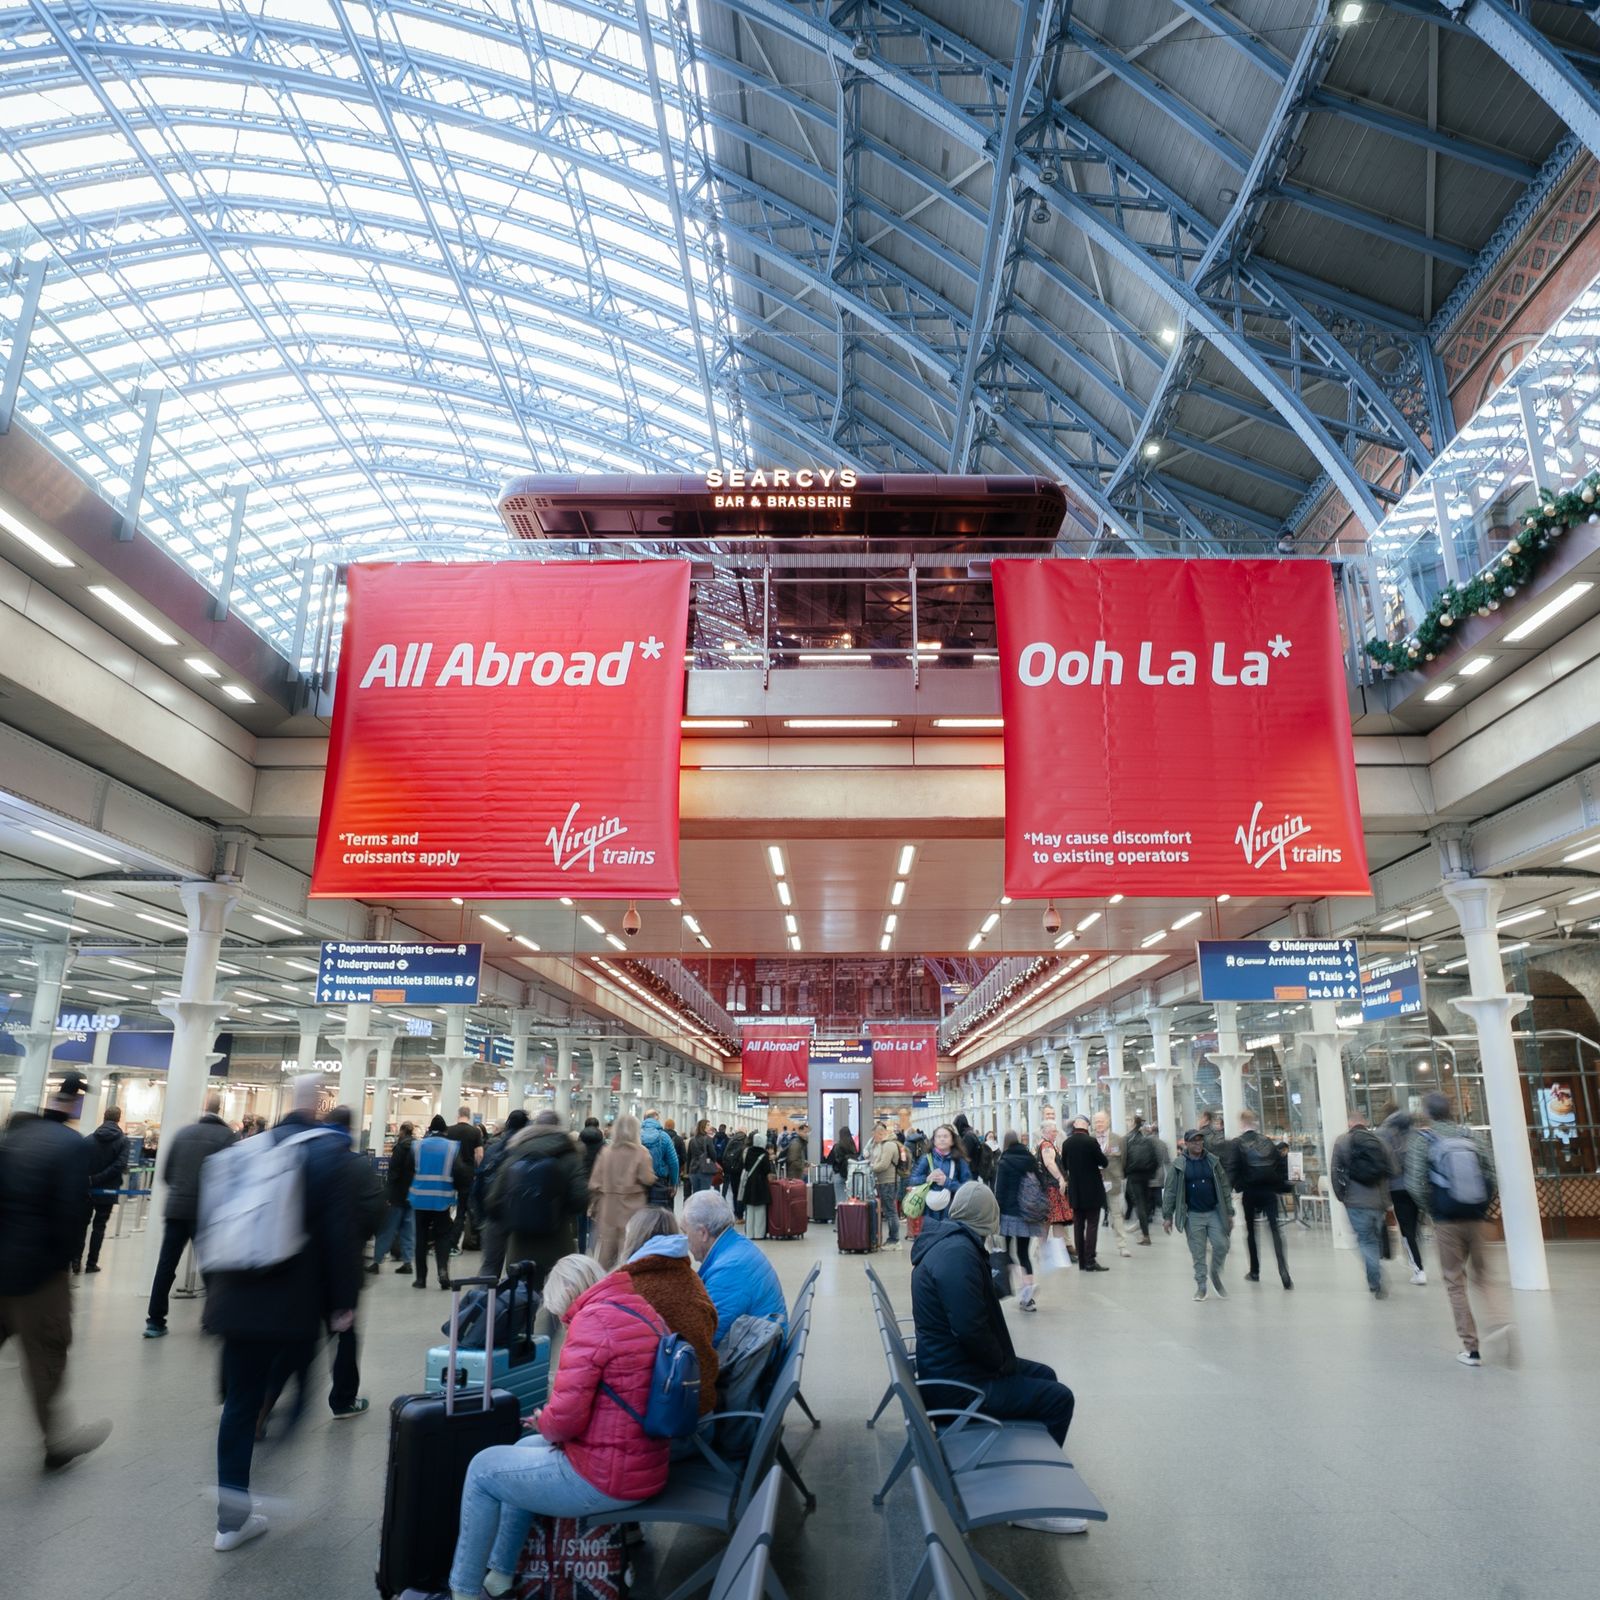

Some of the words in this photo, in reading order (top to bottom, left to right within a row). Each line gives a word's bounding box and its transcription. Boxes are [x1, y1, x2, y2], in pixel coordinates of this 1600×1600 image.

[706, 469, 857, 488] SEARCYS
[715, 495, 745, 508] BAR
[750, 495, 762, 508] &
[767, 495, 852, 508] BRASSERIE
[359, 642, 433, 689] All
[1018, 640, 1124, 687] Ooh
[1137, 641, 1197, 686] La
[391, 832, 419, 846] and
[545, 802, 628, 873] Virgin
[1065, 834, 1109, 846] cause
[1112, 830, 1192, 845] discomfort
[1235, 800, 1312, 871] Virgin
[342, 849, 416, 865] croissants
[419, 849, 460, 867] apply
[602, 846, 656, 865] trains
[1033, 850, 1049, 863] to
[1053, 849, 1115, 866] existing
[1117, 850, 1190, 865] operators
[1292, 845, 1342, 864] trains
[338, 943, 388, 956] Departures
[389, 943, 424, 956] Départs
[1282, 940, 1340, 953] Underground
[336, 958, 396, 971] Underground
[1268, 955, 1306, 966] Arrivées
[1306, 955, 1342, 966] Arrivals
[335, 974, 392, 986] International
[393, 974, 423, 986] tickets
[424, 975, 453, 987] Billets
[1318, 970, 1343, 982] Taxis
[746, 1040, 761, 1051] All
[873, 1040, 894, 1051] Ooh
[896, 1040, 908, 1051] La
[312, 1060, 343, 1073] OOD
[580, 1538, 609, 1557] NOT
[530, 1559, 560, 1574] UST
[564, 1560, 609, 1580] FOOD
